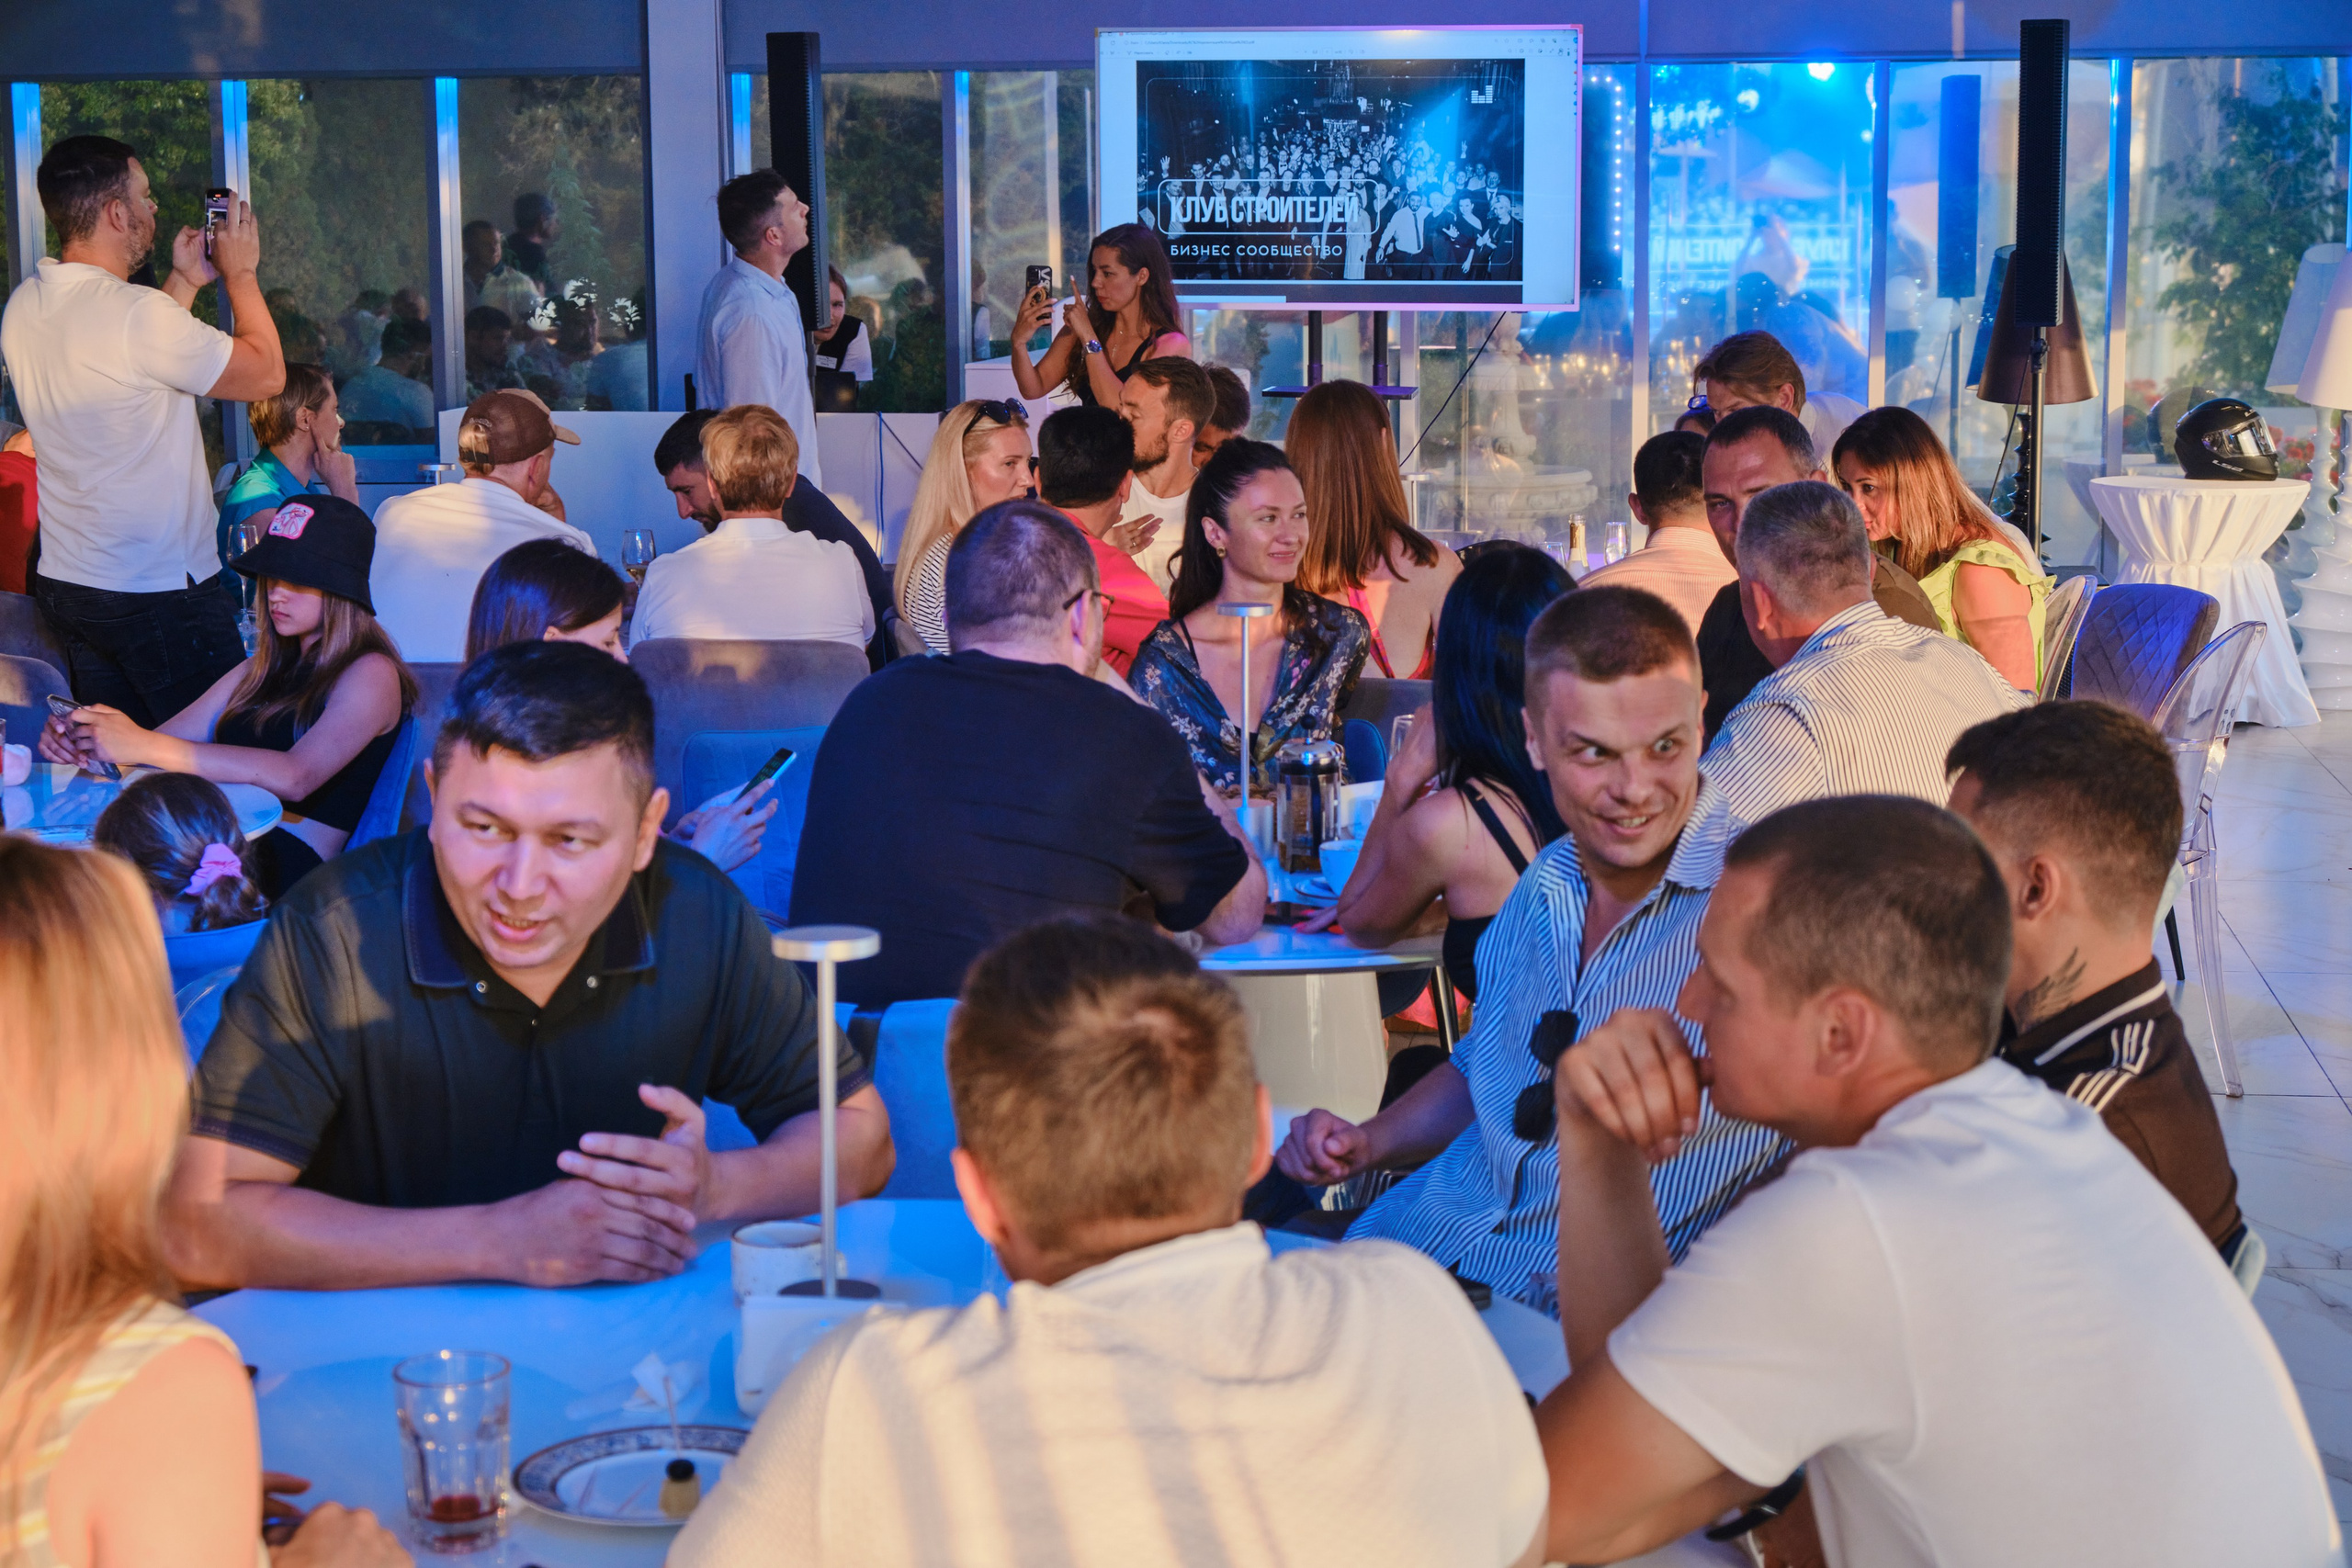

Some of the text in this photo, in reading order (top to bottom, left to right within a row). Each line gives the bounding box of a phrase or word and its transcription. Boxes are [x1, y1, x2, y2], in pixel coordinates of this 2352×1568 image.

[1170, 192, 1358, 222] КЛУБ СТРОИТЕЛЕЙ
[1170, 244, 1342, 257] БИЗНЕС СООБЩЕСТВО
